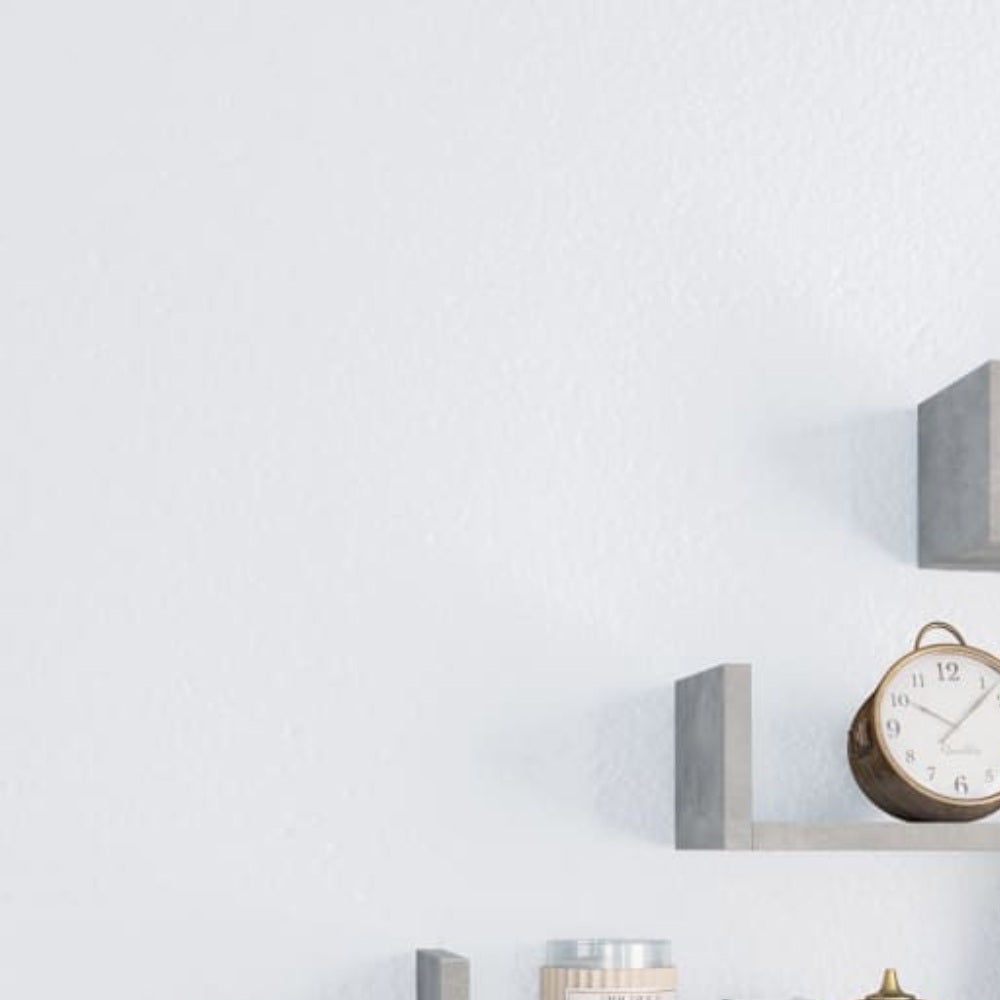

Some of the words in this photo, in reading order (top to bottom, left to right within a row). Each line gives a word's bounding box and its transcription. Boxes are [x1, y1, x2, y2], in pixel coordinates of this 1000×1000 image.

[936, 662, 960, 682] 12
[912, 673, 925, 688] 11
[979, 676, 986, 689] 1
[890, 693, 909, 708] 10
[886, 719, 901, 738] 9
[905, 749, 916, 763] 8
[926, 766, 936, 781] 7
[984, 769, 994, 783] 5
[953, 775, 969, 794] 6
